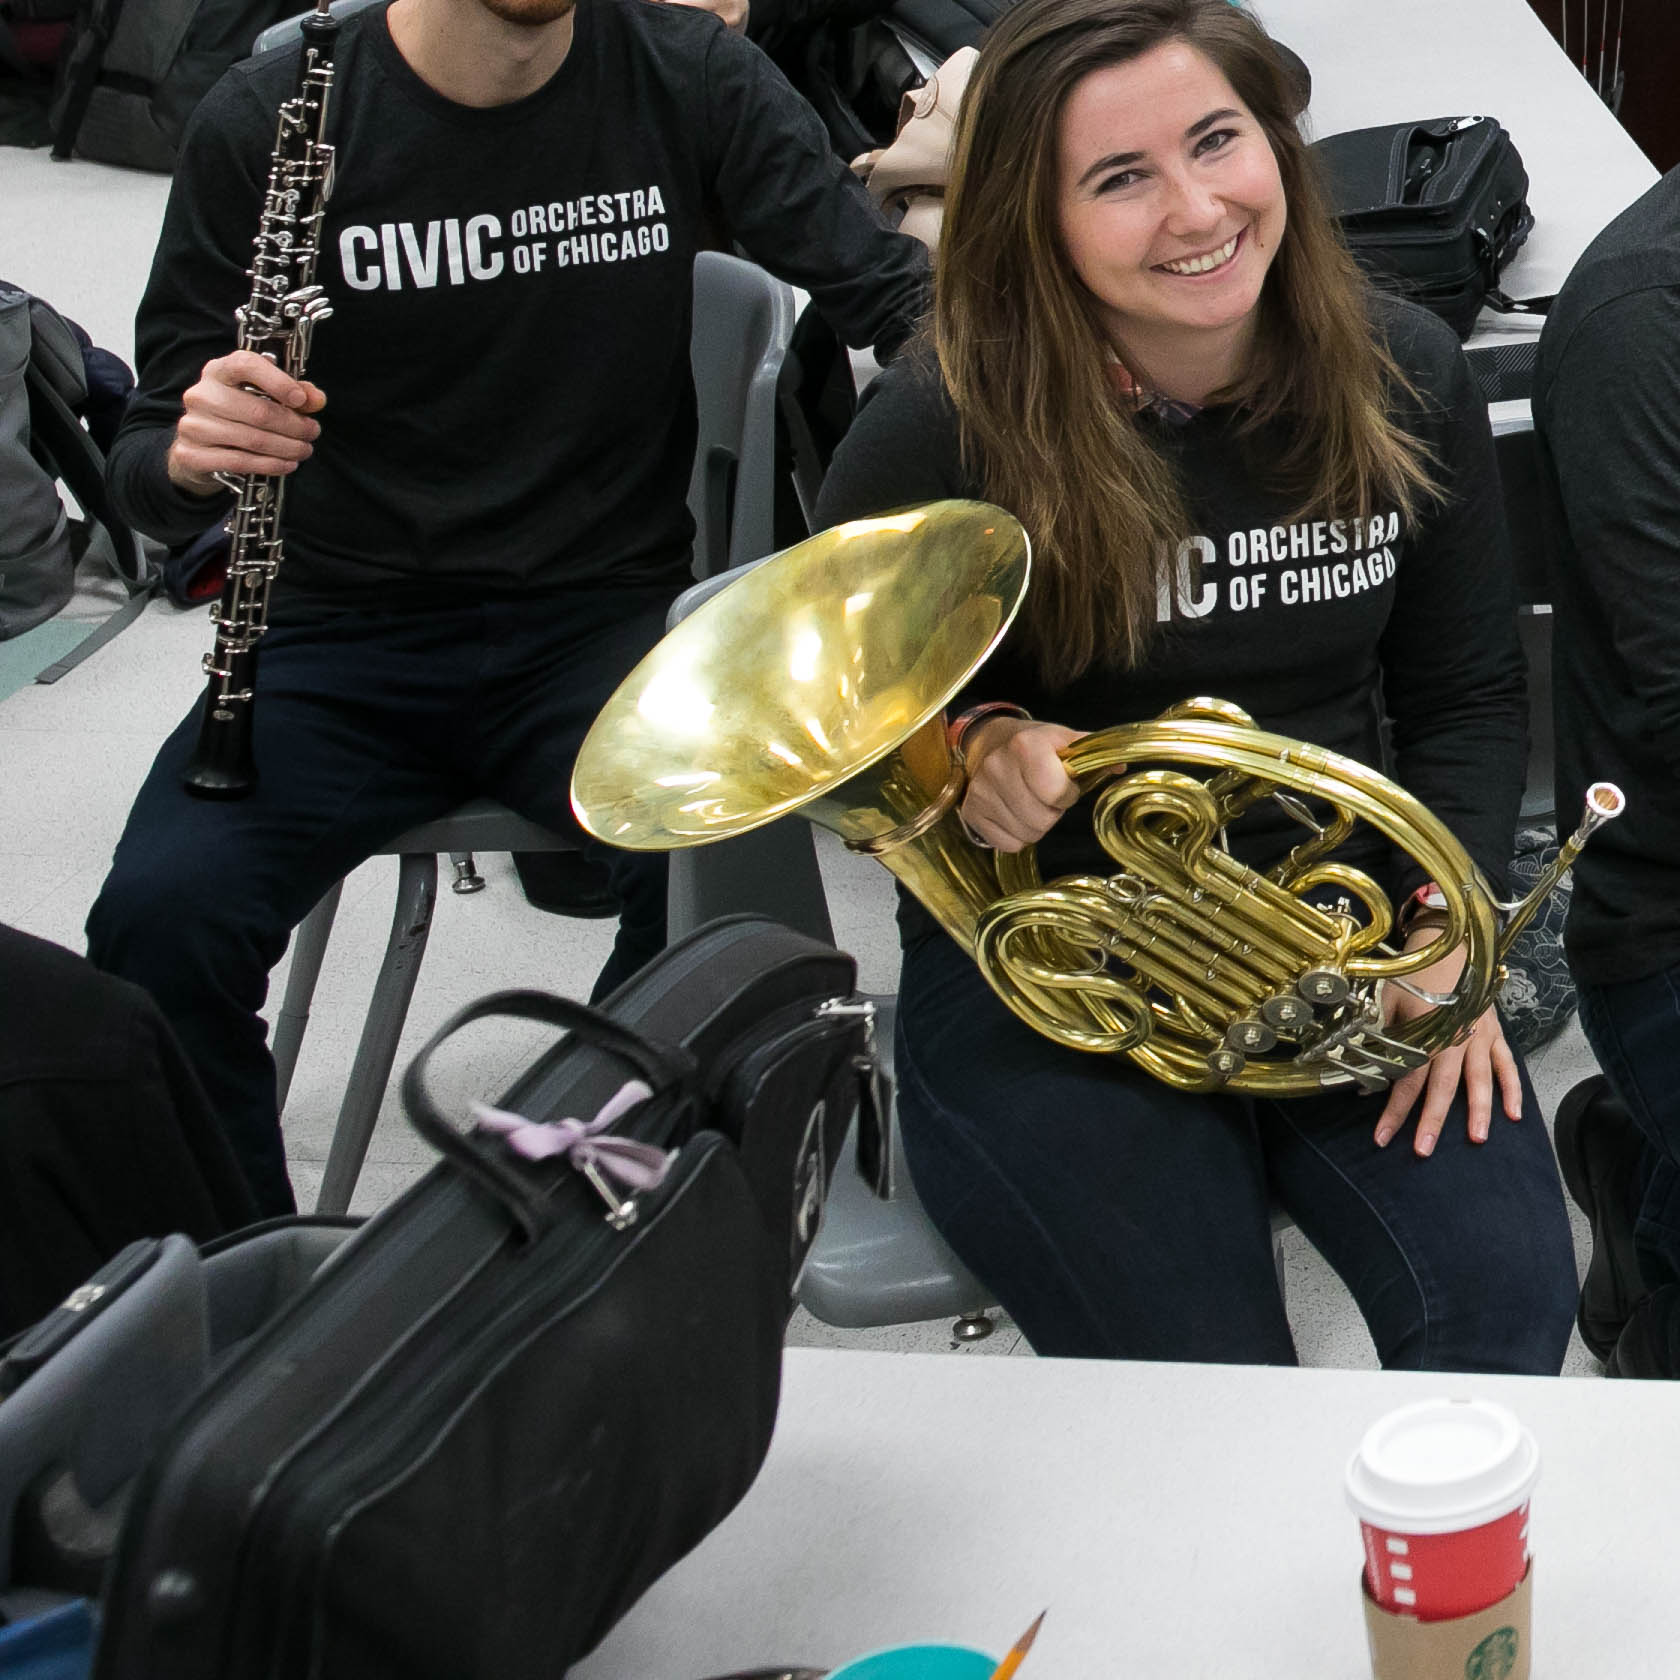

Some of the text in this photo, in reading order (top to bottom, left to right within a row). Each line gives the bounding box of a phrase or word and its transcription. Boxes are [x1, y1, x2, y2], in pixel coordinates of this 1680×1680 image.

[511, 185, 666, 237] ORCHESTRA
[339, 214, 504, 291] CIVIC
[513, 222, 669, 274] OF CHICAGO
[1228, 511, 1399, 567] ORCHESTRA
[1229, 573, 1267, 612] OF
[1280, 546, 1396, 605] CHICAGO
